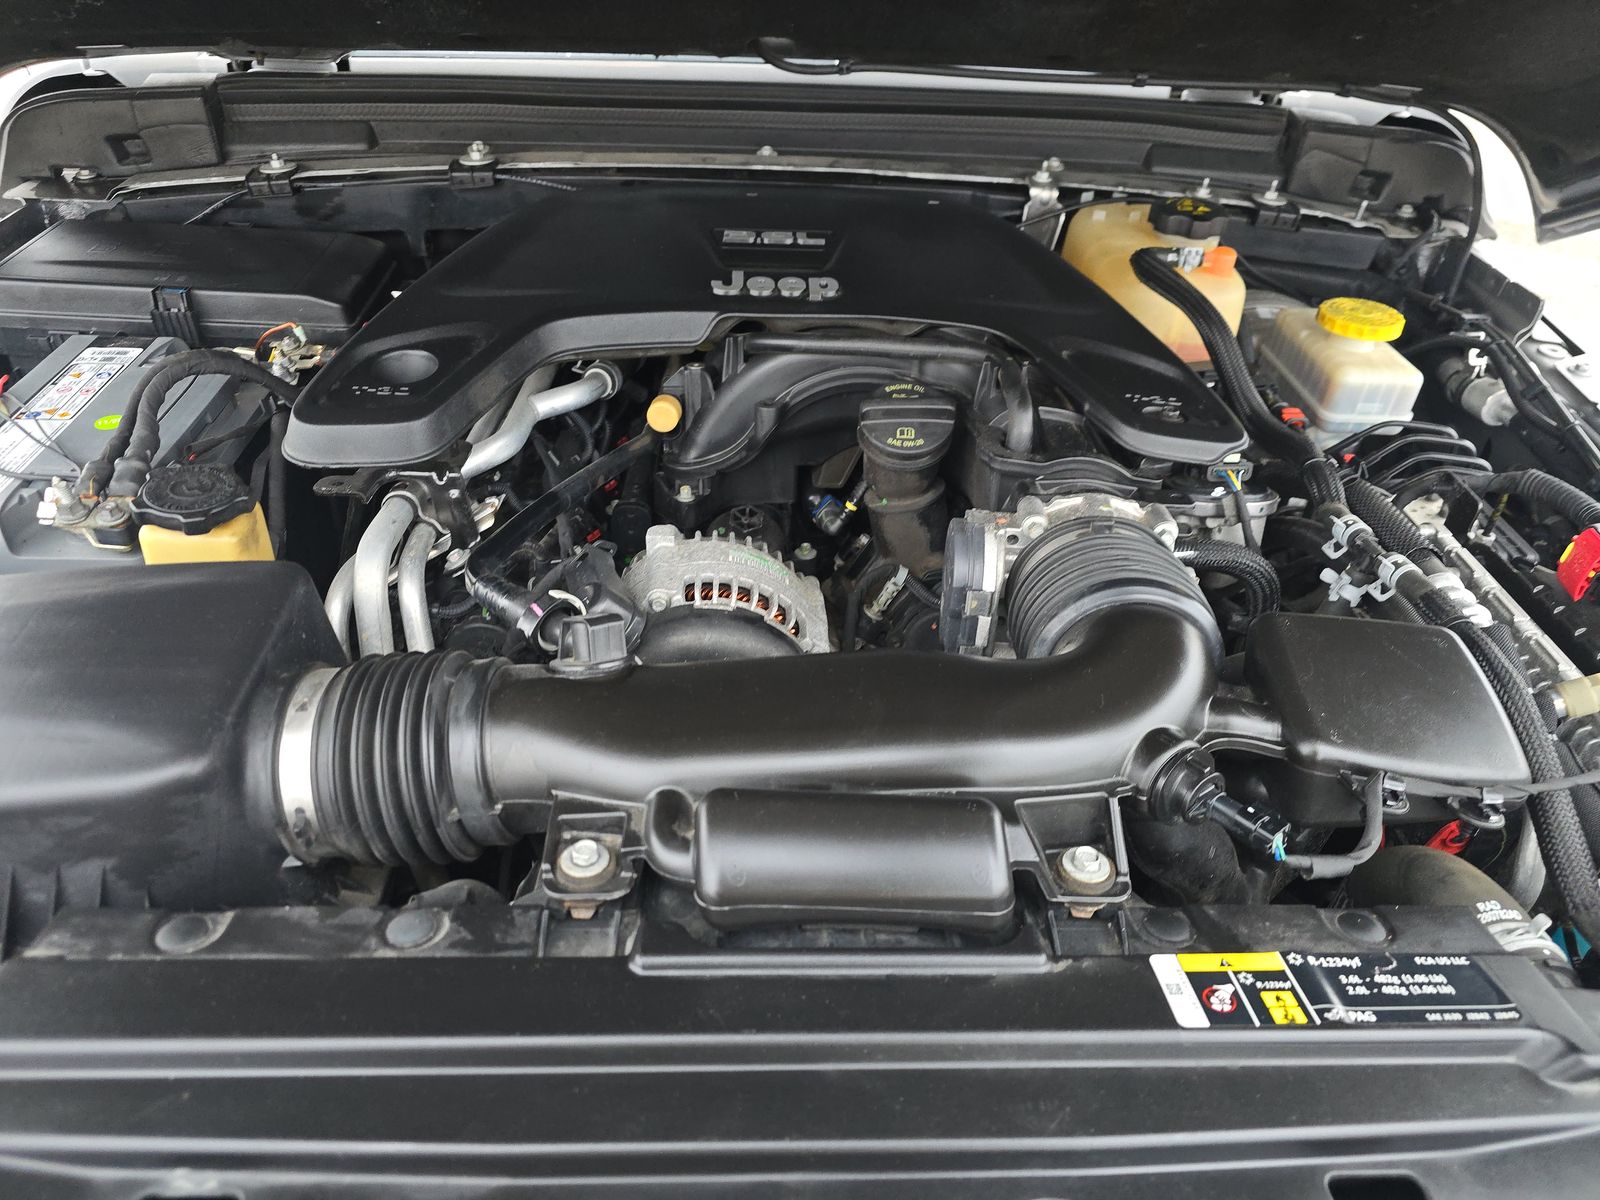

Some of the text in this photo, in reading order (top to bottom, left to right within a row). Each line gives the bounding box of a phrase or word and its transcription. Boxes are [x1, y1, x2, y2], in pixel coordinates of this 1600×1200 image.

[710, 270, 840, 301] Jeep
[884, 383, 926, 393] ENGINE OIL
[886, 437, 903, 447] SAE
